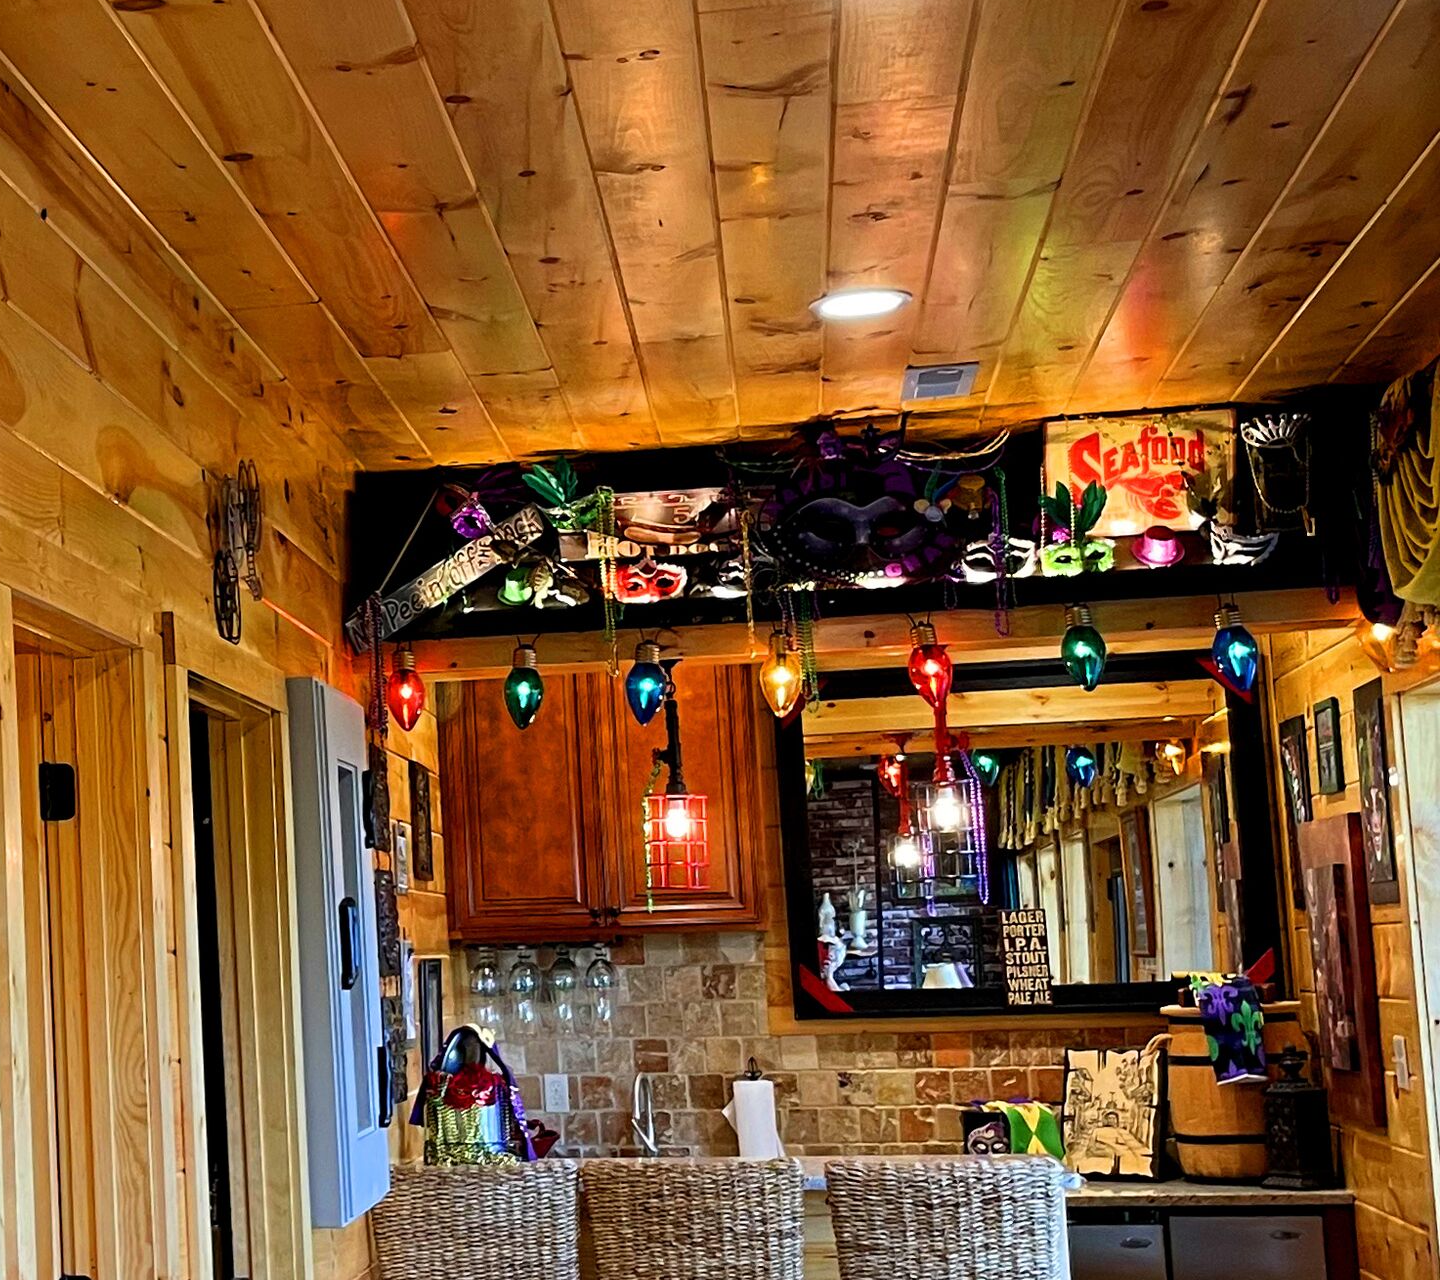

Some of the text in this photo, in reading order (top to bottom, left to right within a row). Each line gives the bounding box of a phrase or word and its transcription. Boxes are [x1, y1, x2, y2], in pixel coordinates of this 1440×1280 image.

[1001, 910, 1044, 924] LAGER
[1002, 923, 1046, 937] PORTER
[1003, 937, 1047, 951] I.P.A.
[1005, 951, 1047, 965] STOUT
[1006, 964, 1049, 978] PILSNER
[1007, 978, 1050, 991] WHEAT
[1008, 990, 1053, 1005] PALE ALE
